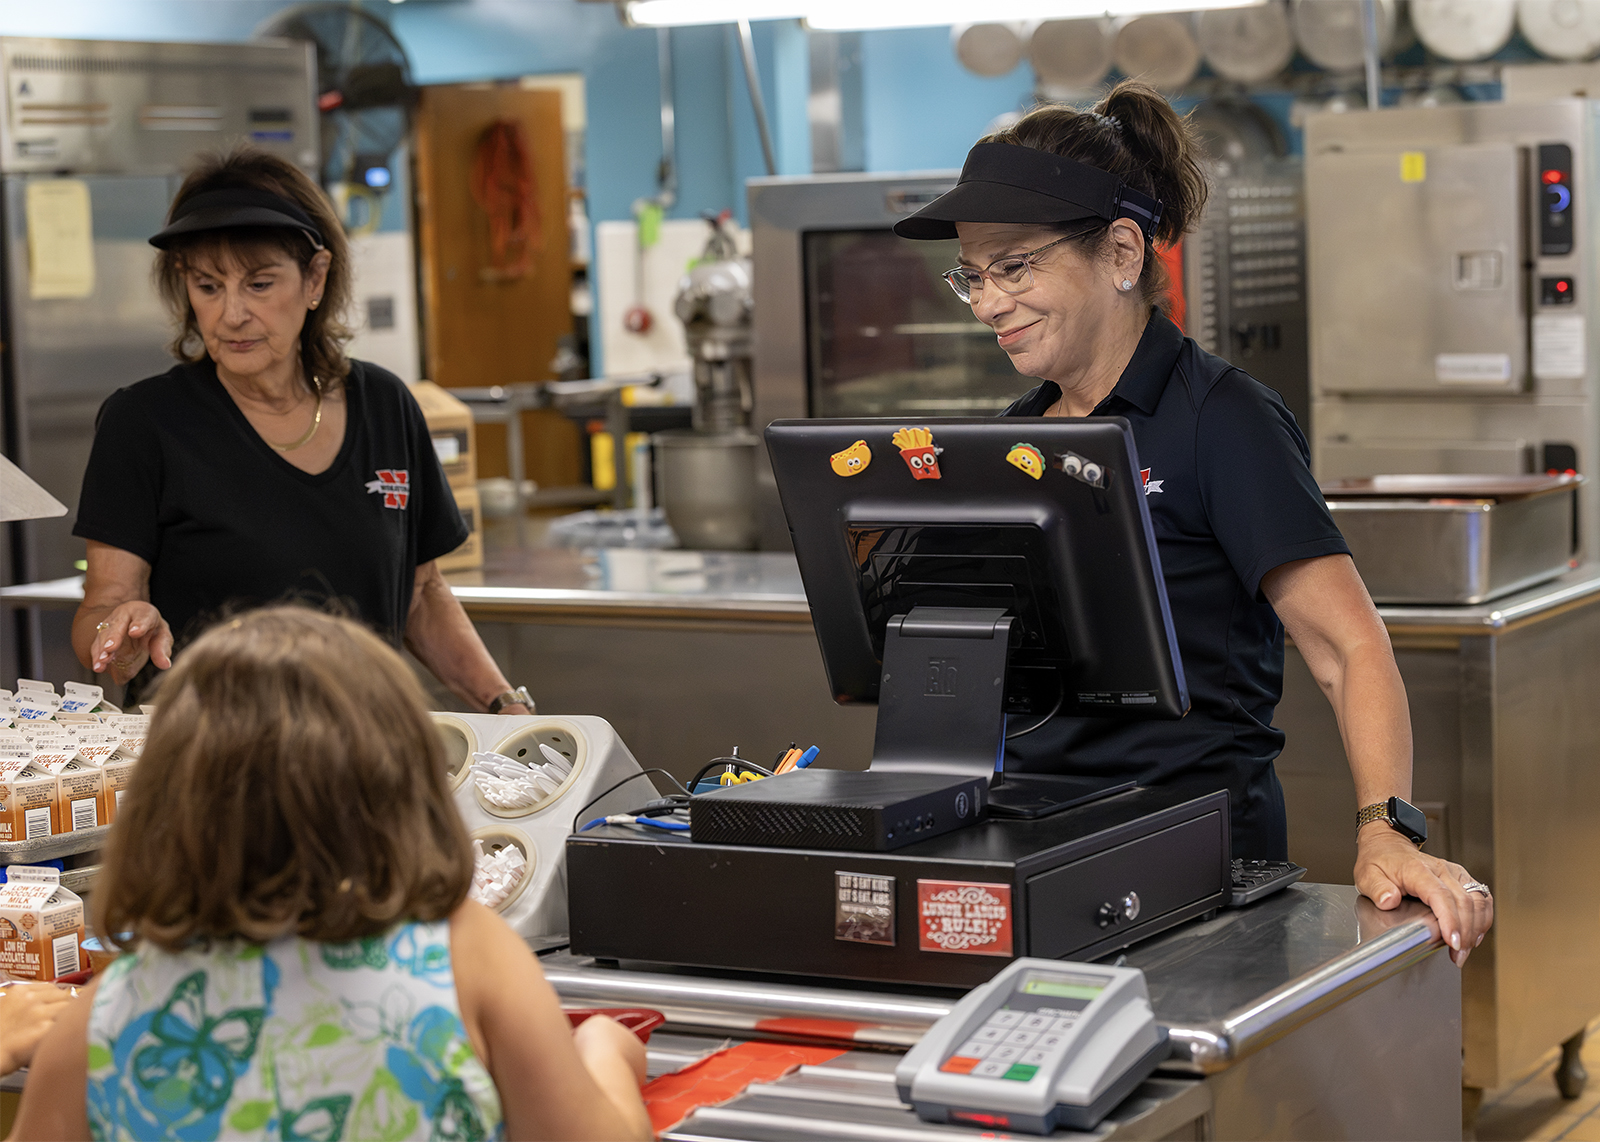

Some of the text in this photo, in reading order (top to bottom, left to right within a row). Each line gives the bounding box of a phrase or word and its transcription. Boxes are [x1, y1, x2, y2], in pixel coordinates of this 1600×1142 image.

[922, 901, 1007, 920] LUNCH LADIES
[941, 918, 988, 934] RULE!
[4, 941, 27, 952] LOW FAT
